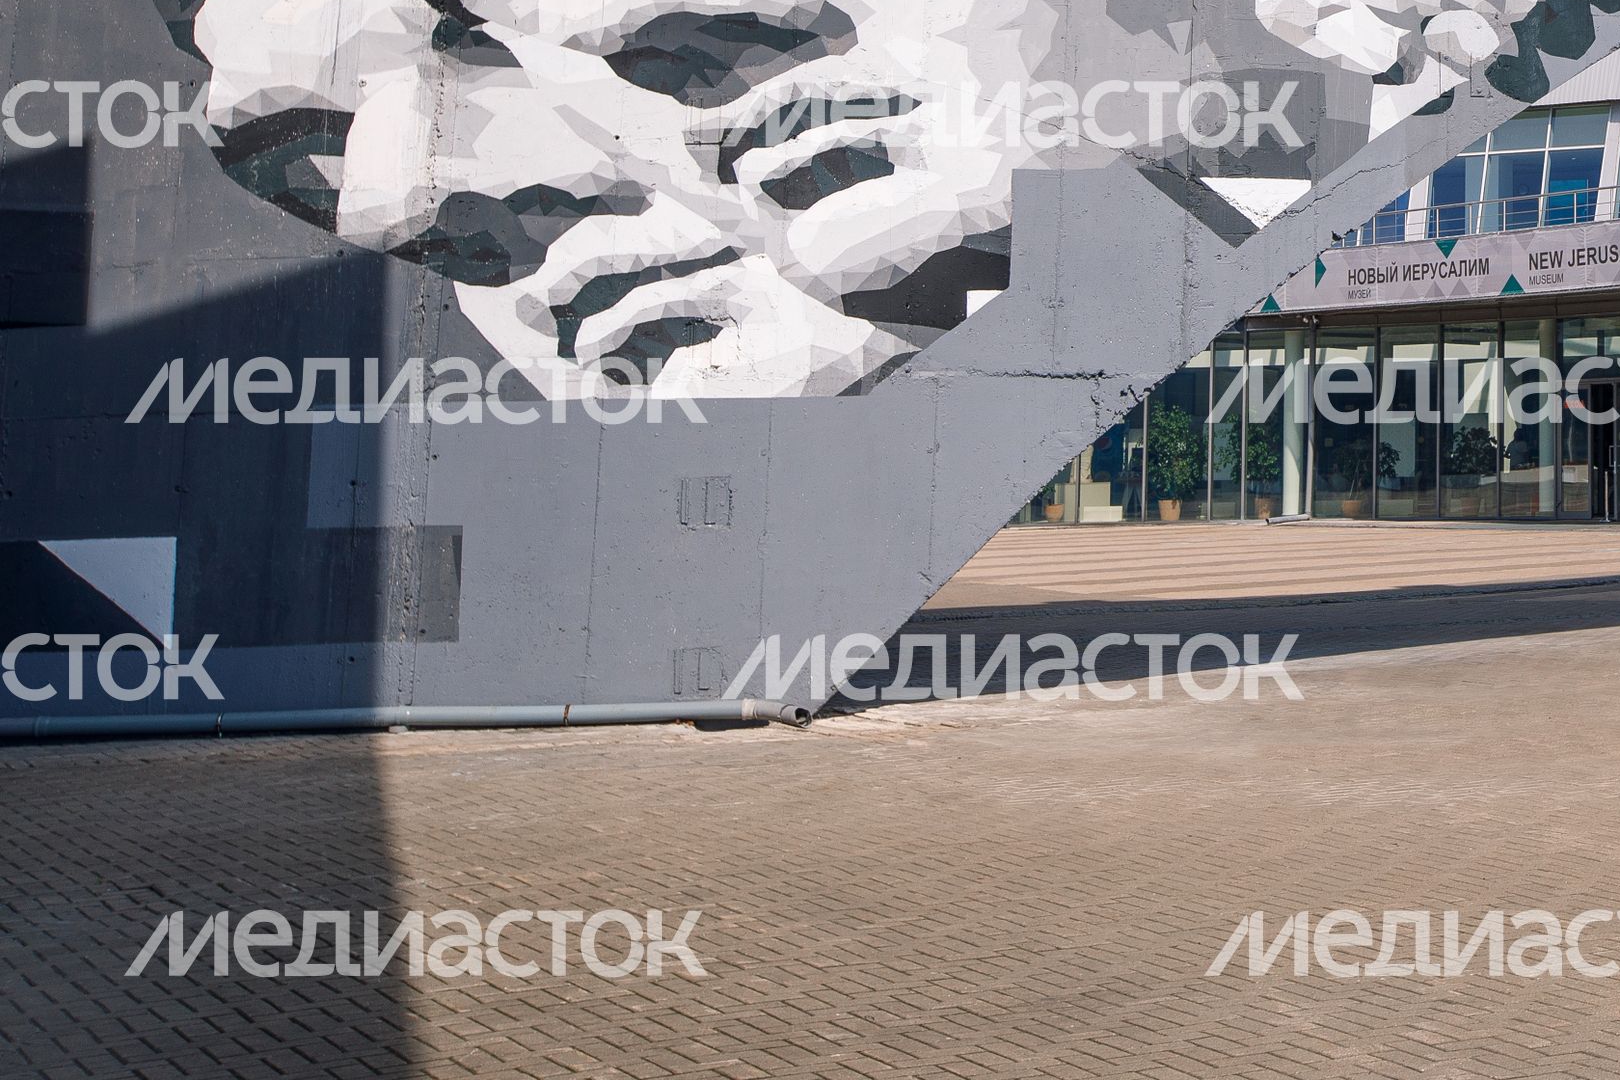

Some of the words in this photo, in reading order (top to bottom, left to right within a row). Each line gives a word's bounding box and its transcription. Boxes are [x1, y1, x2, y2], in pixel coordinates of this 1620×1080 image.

[1528, 250, 1564, 271] NEW
[1347, 262, 1399, 286] НОВЫЙ
[1402, 257, 1490, 282] ИЕРУСАЛИМ
[1528, 273, 1564, 286] MUSEUM
[1347, 287, 1372, 300] МУЗЕЙ
